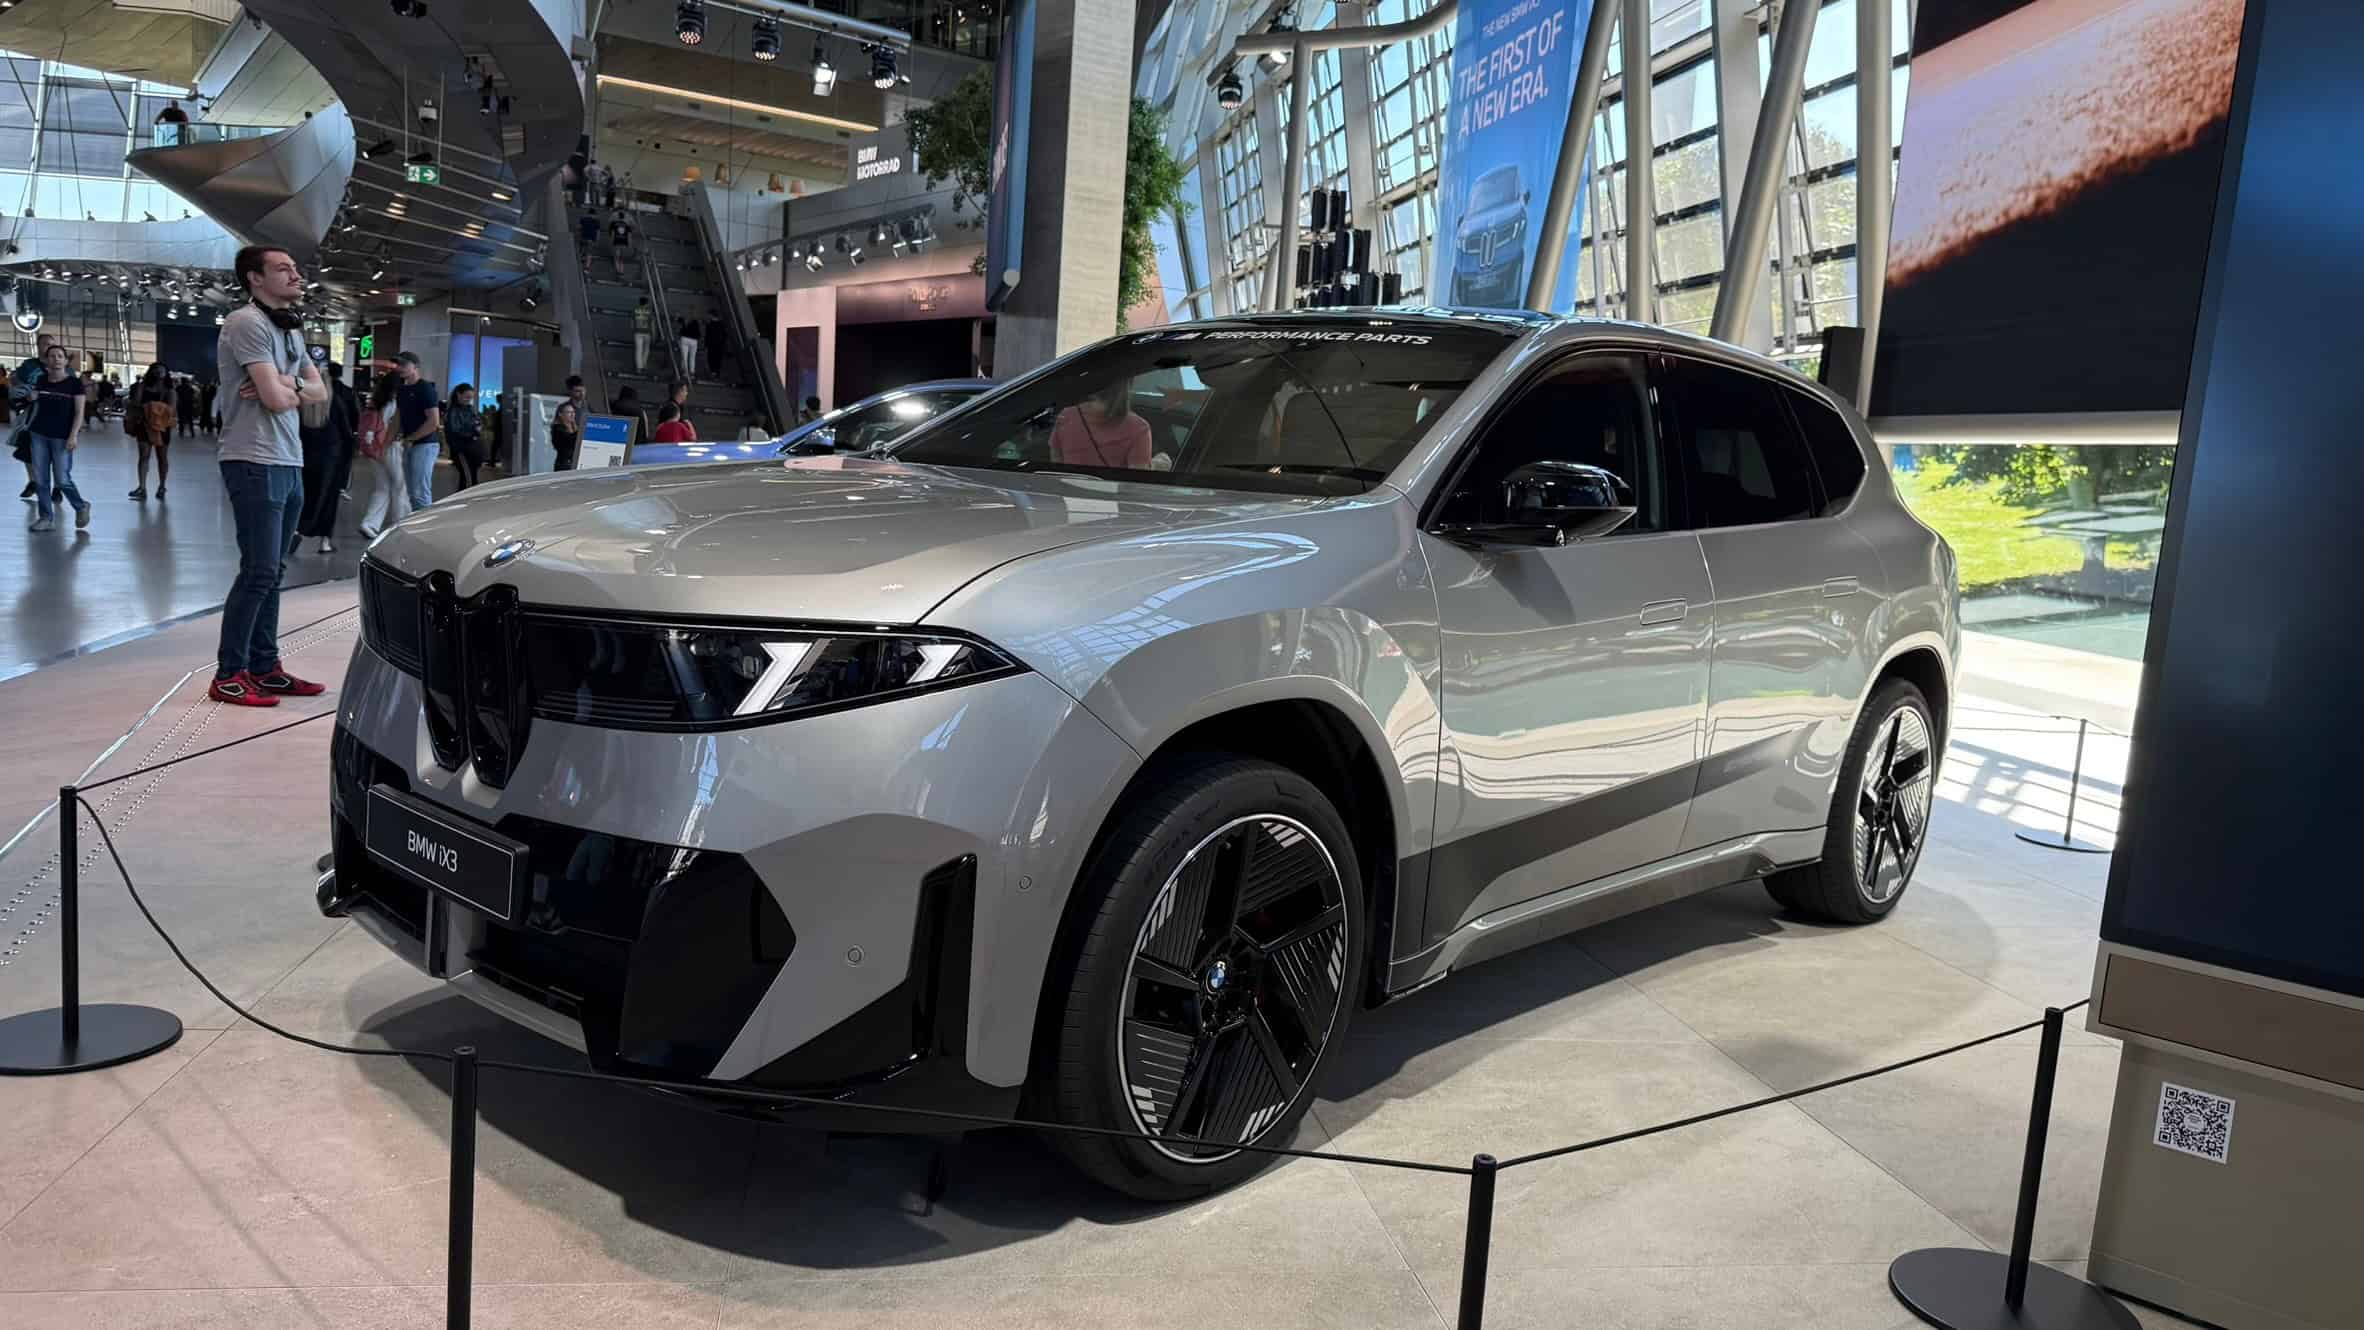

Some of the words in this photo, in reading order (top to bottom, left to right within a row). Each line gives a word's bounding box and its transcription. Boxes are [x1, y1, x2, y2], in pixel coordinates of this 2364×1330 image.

[1458, 56, 1489, 101] THE
[1489, 26, 1538, 85] FIRST
[1538, 9, 1565, 57] OF
[1458, 104, 1470, 138] A
[1471, 82, 1509, 133] NEW
[1509, 63, 1549, 114] ERA.
[857, 146, 878, 164] BMW
[857, 157, 900, 180] MOTORRAD
[1203, 331, 1355, 341] PERFORMANCE
[1353, 332, 1433, 345] PARTS
[407, 830, 437, 863] BMW
[439, 844, 458, 872] iX3
